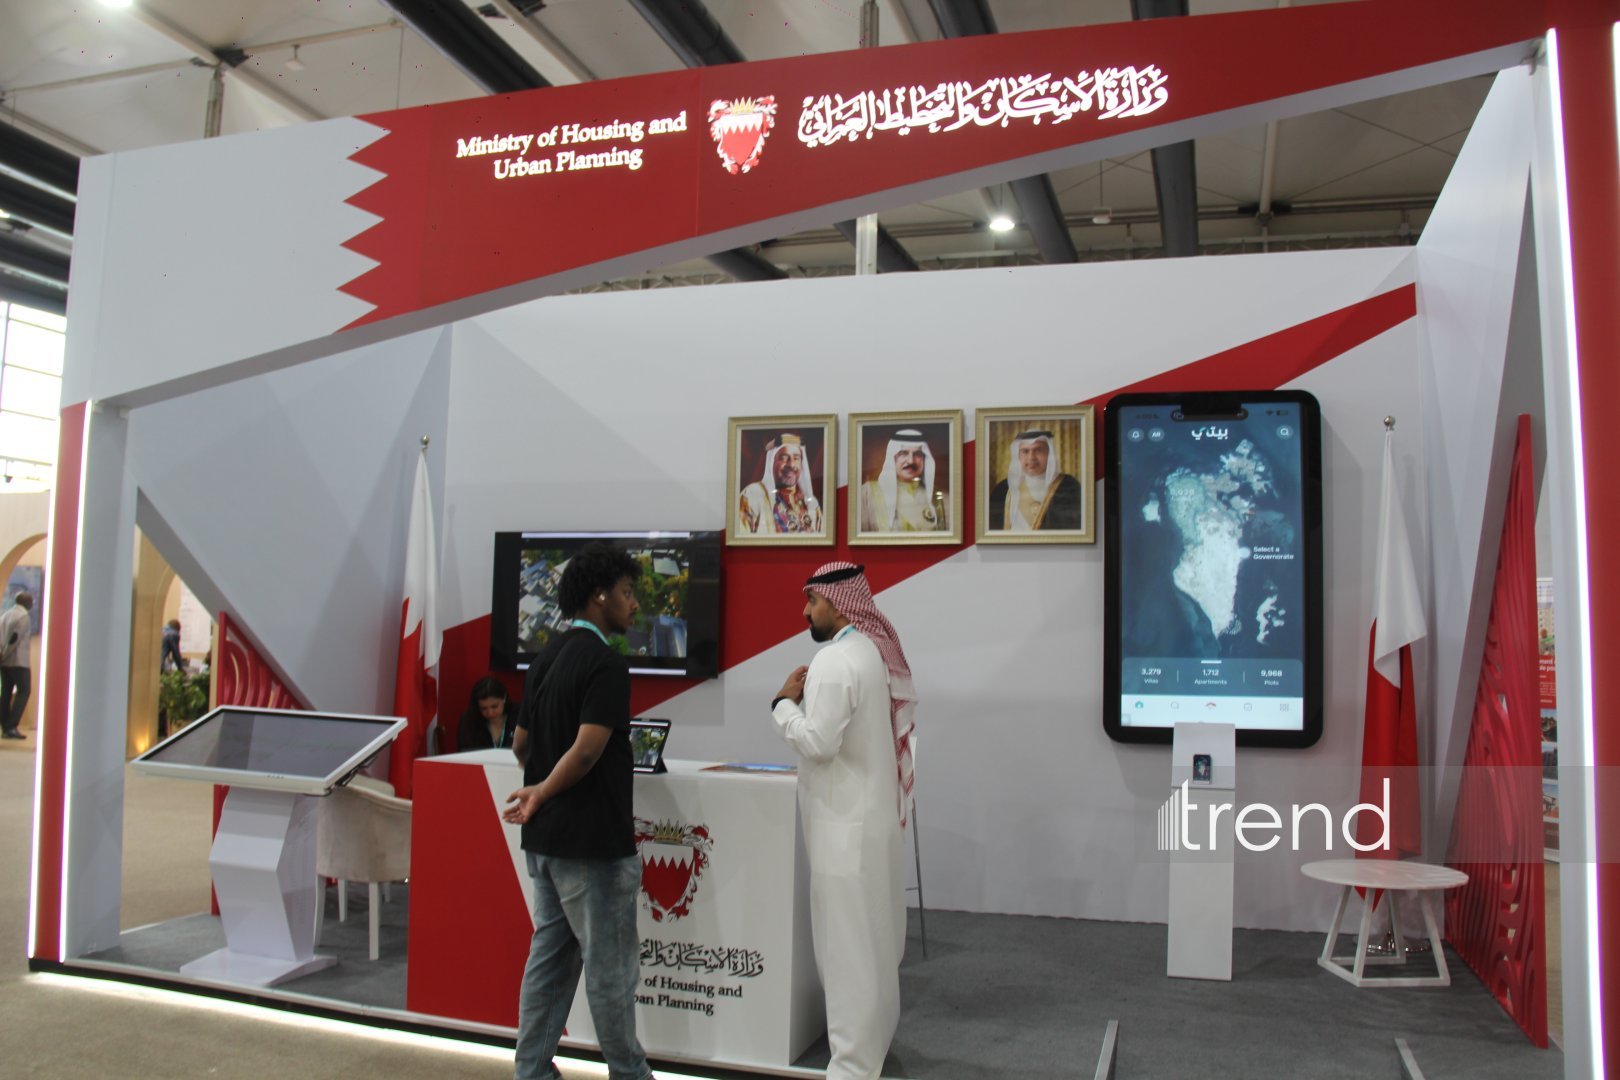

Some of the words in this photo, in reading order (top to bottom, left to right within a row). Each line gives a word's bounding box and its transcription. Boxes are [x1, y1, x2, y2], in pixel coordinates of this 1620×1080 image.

[873, 78, 977, 138] والتخطيط
[1097, 64, 1168, 120] وزارة
[456, 136, 533, 158] Ministry
[537, 125, 559, 146] of
[561, 119, 645, 144] Housing
[648, 111, 688, 134] and
[797, 90, 876, 148] العمراني
[494, 157, 552, 180] Urban
[555, 147, 643, 173] Planning
[727, 946, 765, 978] وزارة
[644, 976, 658, 988] of
[660, 976, 715, 998] Housing
[718, 985, 743, 998] and
[657, 994, 714, 1017] Planning
